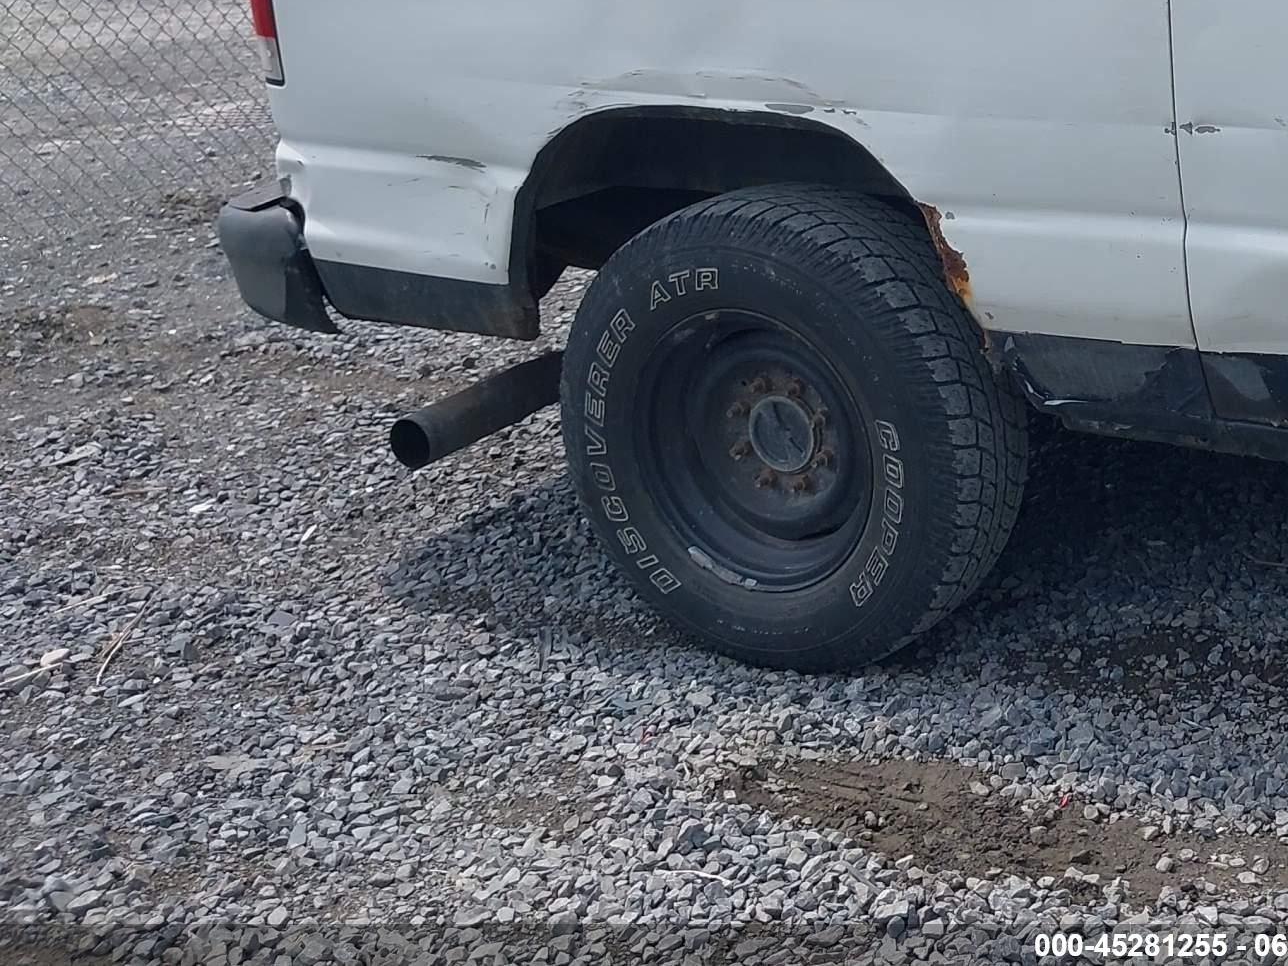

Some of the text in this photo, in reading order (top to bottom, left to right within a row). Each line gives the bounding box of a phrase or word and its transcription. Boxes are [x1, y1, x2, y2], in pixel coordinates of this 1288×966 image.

[583, 267, 718, 595] DISCOVERER ATR
[849, 419, 905, 607] COOPER
